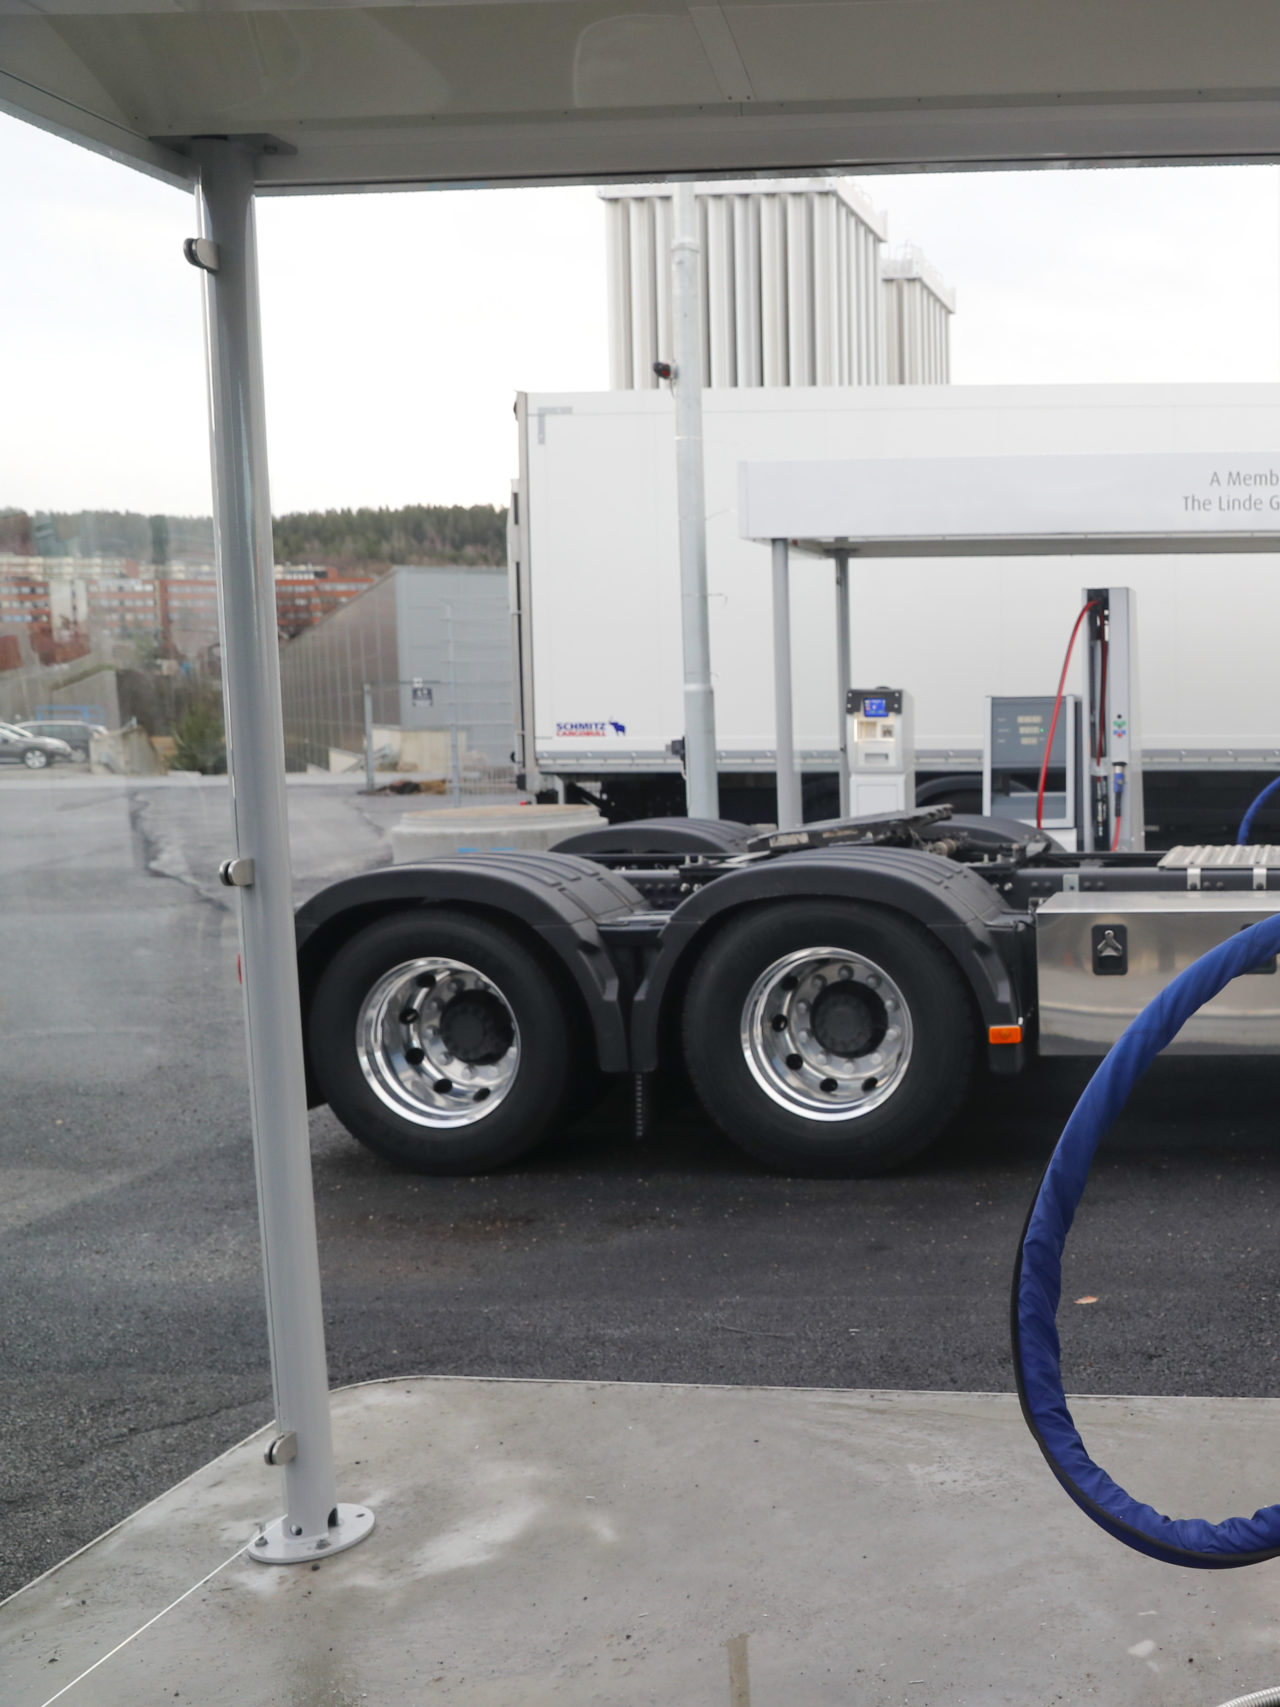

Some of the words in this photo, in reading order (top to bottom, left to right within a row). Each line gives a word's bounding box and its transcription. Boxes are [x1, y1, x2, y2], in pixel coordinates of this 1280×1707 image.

[1209, 471, 1222, 486] A
[1182, 494, 1212, 511] The
[1218, 494, 1263, 511] Linde
[556, 722, 606, 730] SCHMITZ
